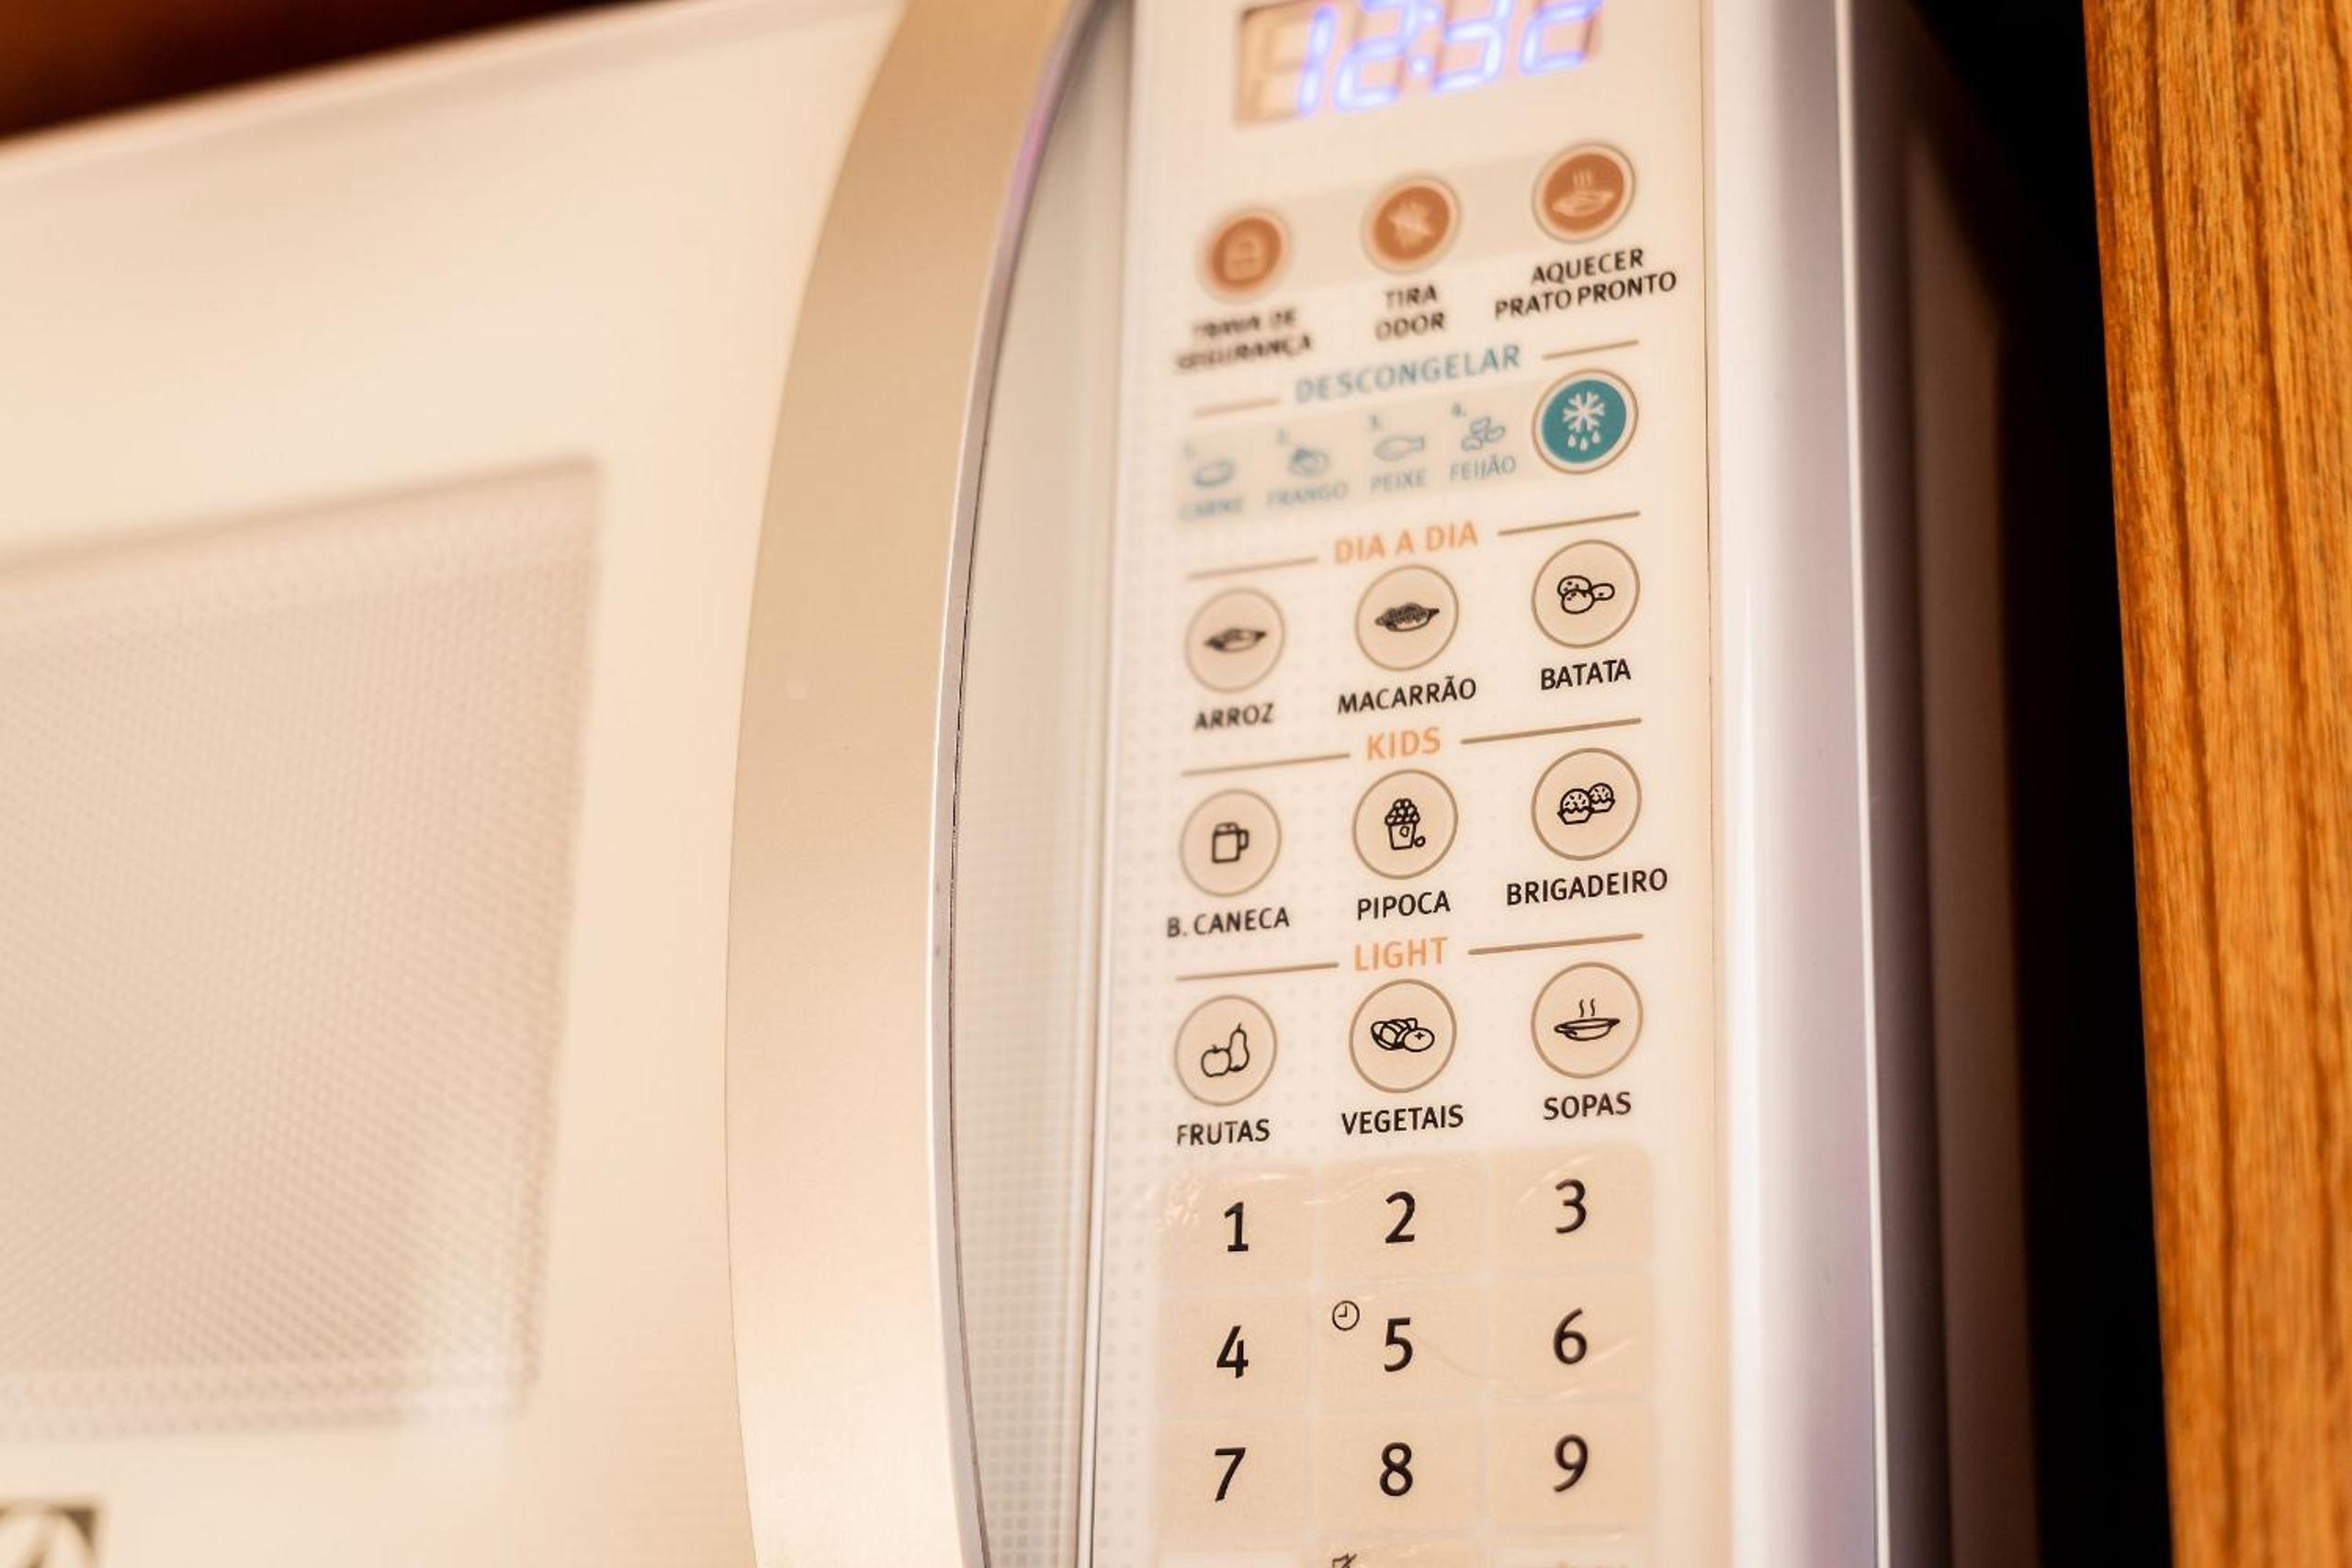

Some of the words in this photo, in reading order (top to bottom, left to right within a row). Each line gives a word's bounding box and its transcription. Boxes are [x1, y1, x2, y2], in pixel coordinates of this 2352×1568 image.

[1530, 247, 1645, 286] AQUECER
[1385, 284, 1439, 310] TIRA
[1494, 289, 1572, 321] PRATO
[1577, 270, 1678, 307] PRONTO
[1374, 311, 1445, 342] ODOR
[1295, 344, 1521, 402] DESCONGELAR
[1369, 469, 1427, 492] PEIXE
[1450, 455, 1517, 482] FEIJÃO
[1334, 534, 1385, 565] DIA
[1396, 528, 1415, 555] A
[1425, 520, 1478, 551] DIA
[1541, 658, 1631, 691] BATATA
[1338, 677, 1476, 715] MACARRÃO
[1194, 703, 1274, 729] ARROZ
[1366, 728, 1441, 761] KIDS
[1356, 891, 1451, 920] PIPOCA
[1506, 868, 1668, 906] BRIGADEIRO
[1167, 917, 1189, 937] B.
[1194, 907, 1290, 936] CANECA
[1354, 937, 1448, 972] LIGHT
[1341, 1104, 1464, 1135] VEGETAIS
[1543, 1092, 1632, 1121] SOPAS
[1176, 1120, 1271, 1146] FRUTAS
[1385, 1190, 1416, 1244] 2
[1555, 1179, 1588, 1234] 3
[1223, 1201, 1250, 1252] 1
[1216, 1325, 1250, 1379] 4
[1384, 1316, 1414, 1372] 5
[1553, 1308, 1588, 1365] 6
[1214, 1447, 1247, 1502] 7
[1379, 1442, 1414, 1497] 8
[1553, 1434, 1589, 1493] 9
